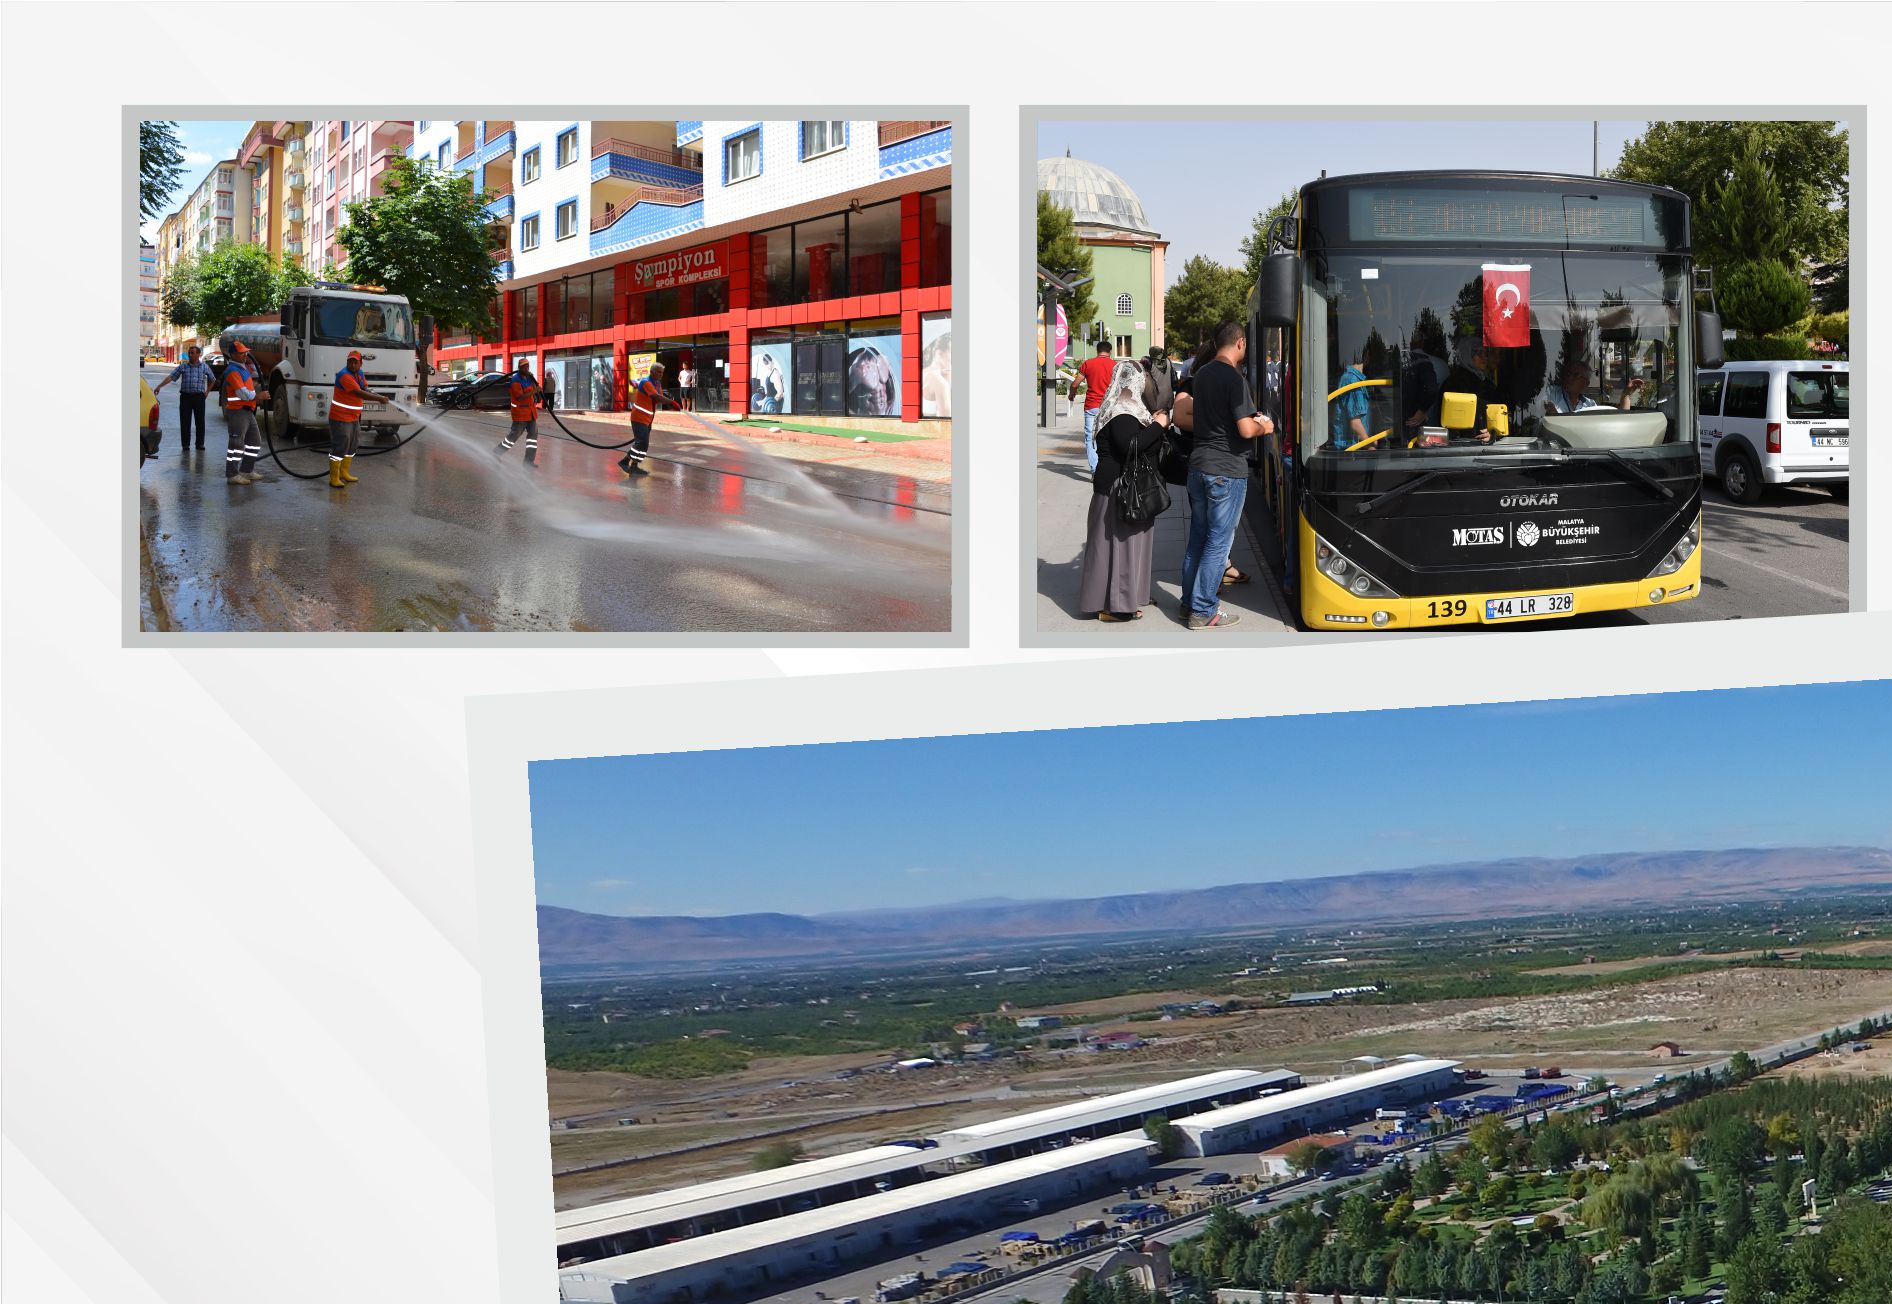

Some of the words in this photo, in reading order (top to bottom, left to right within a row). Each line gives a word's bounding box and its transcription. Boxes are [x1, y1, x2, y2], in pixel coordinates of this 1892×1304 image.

[635, 249, 715, 284] Şampiyon
[656, 278, 674, 287] SPOR
[1500, 493, 1559, 507] OTOKAR
[1557, 518, 1585, 526] MALATYA
[1427, 599, 1467, 619] 139
[1497, 600, 1512, 615] 44
[1520, 598, 1536, 614] LR
[1548, 595, 1571, 611] 328
